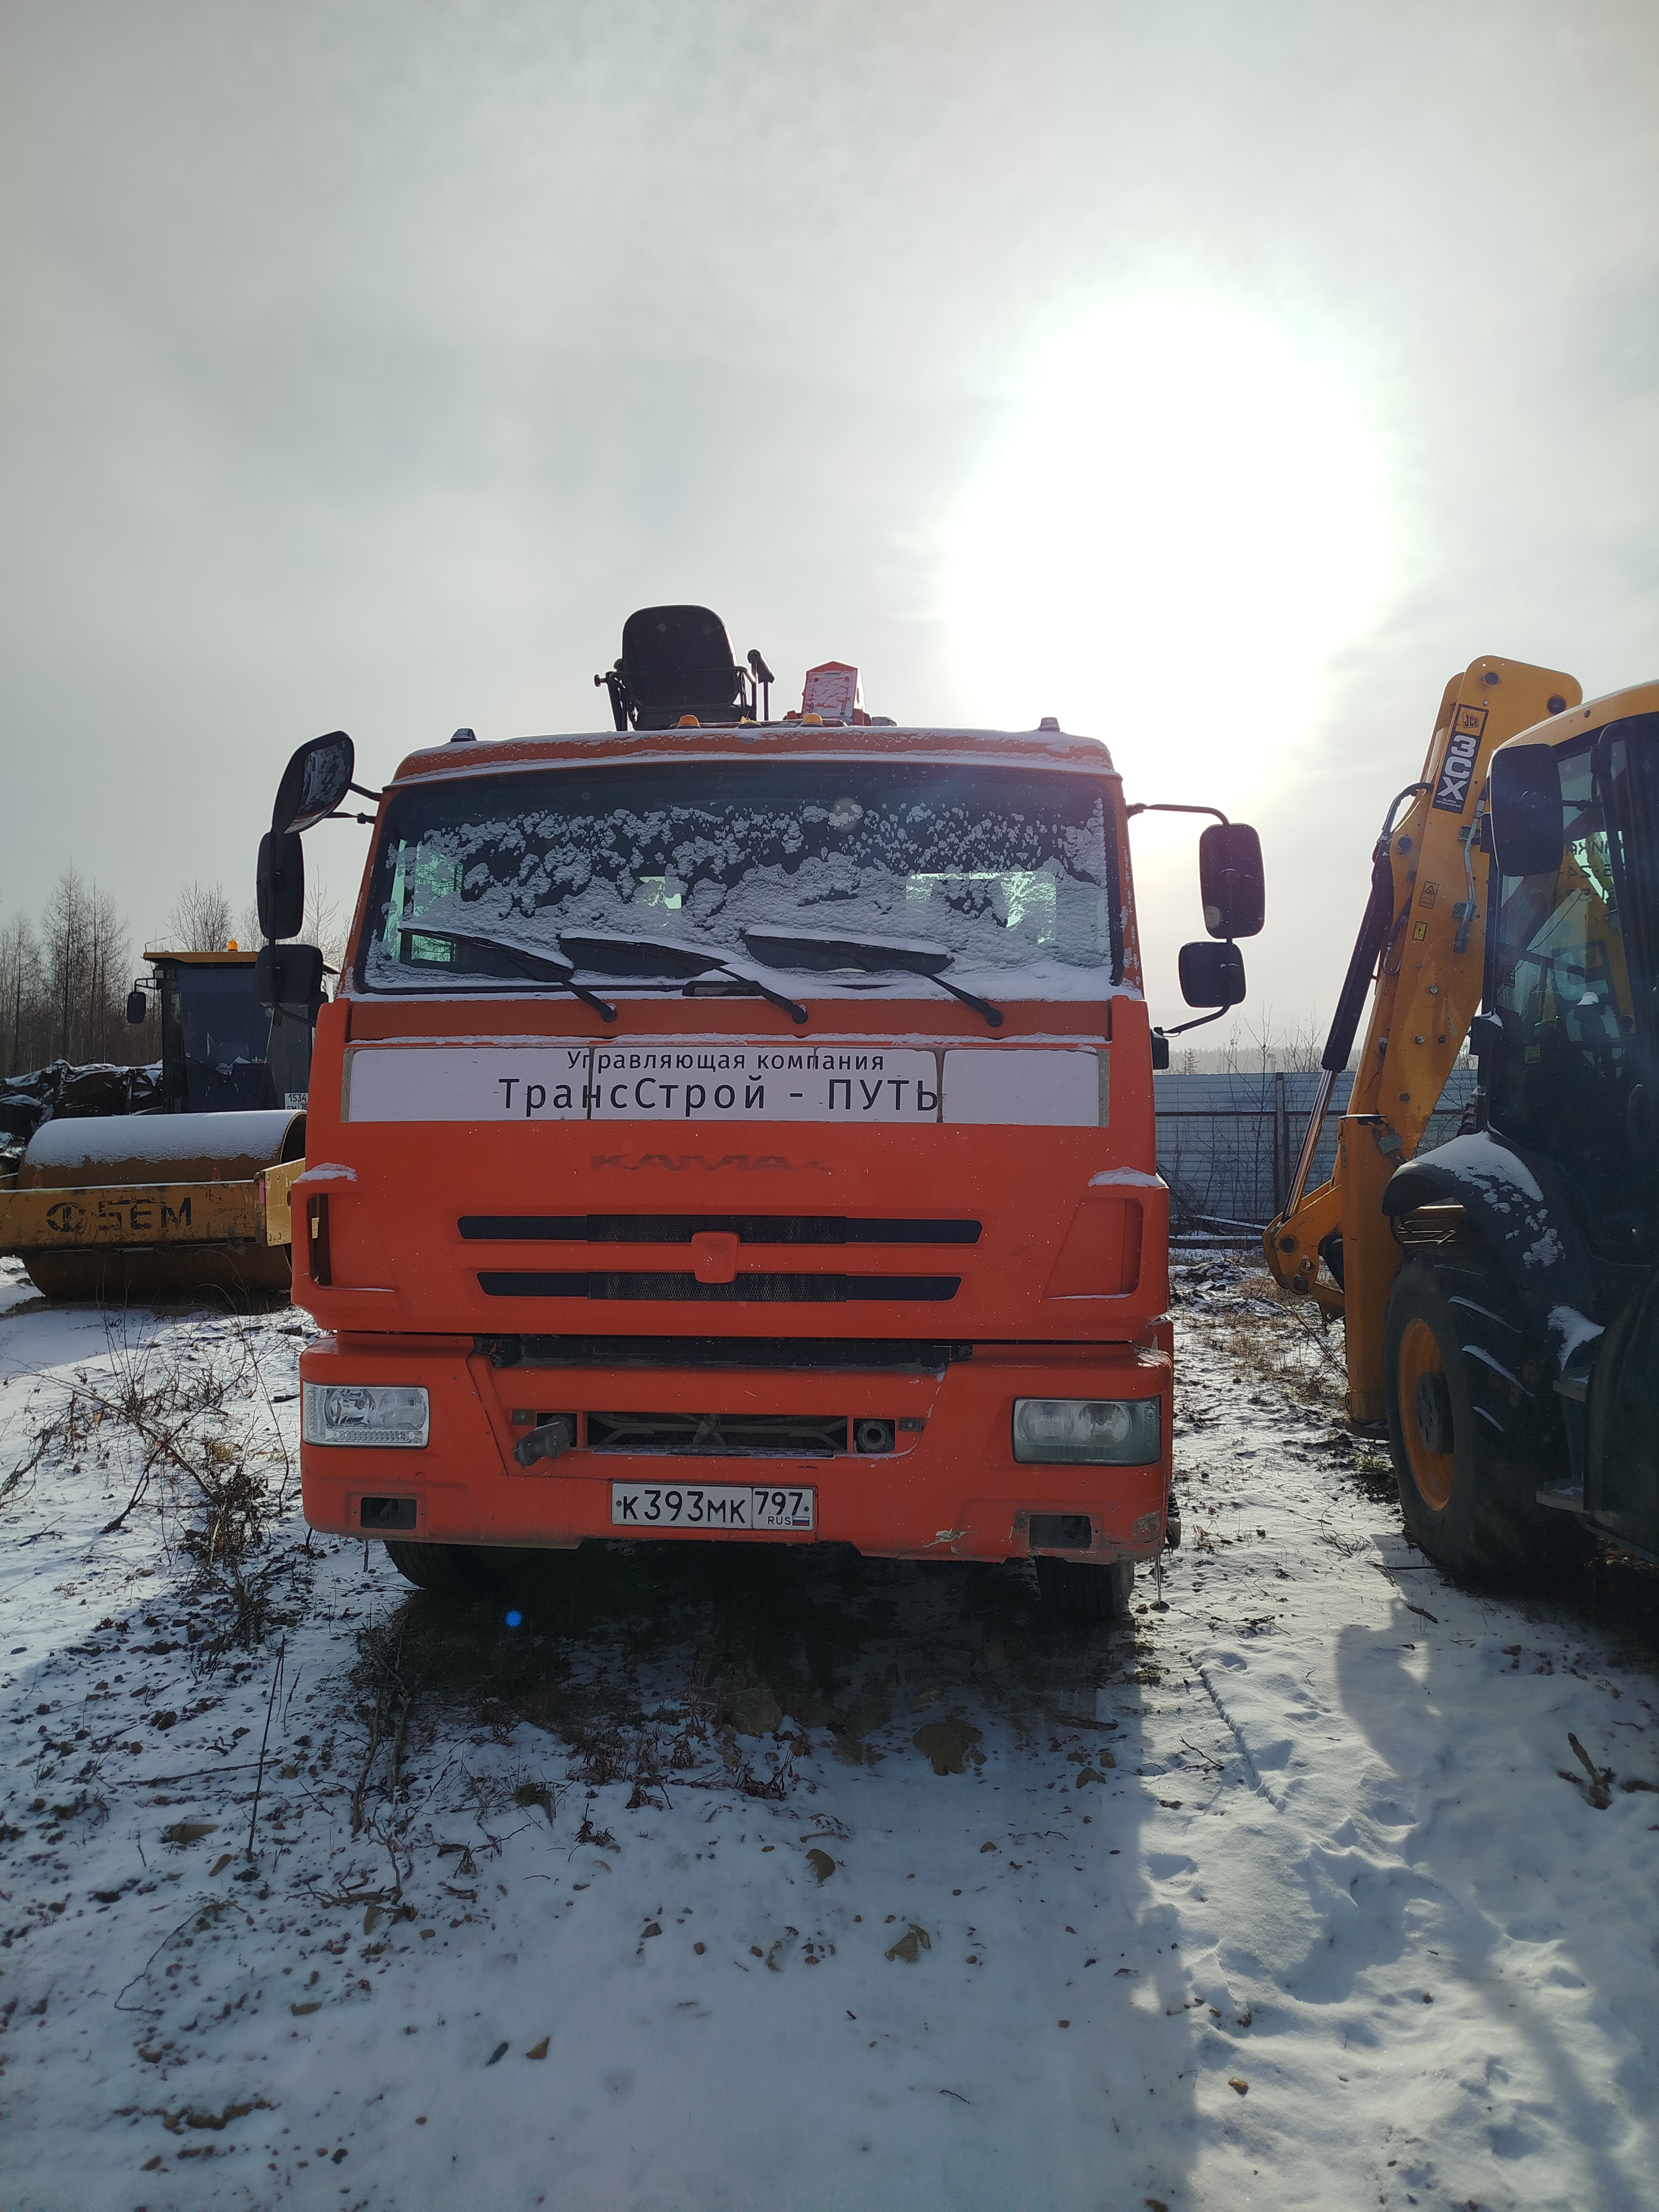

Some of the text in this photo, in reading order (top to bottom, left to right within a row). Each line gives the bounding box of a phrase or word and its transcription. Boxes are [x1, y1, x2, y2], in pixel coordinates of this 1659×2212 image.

[1464, 715, 1479, 727] JCB
[1437, 735, 1477, 801] 3CX
[567, 1051, 884, 1074] Управляющая компания
[288, 1094, 307, 1103] 1534
[498, 1074, 764, 1117] ТрансСтрой
[829, 1079, 938, 1111] ПУТЬ
[98, 1197, 191, 1232] SEM
[622, 1489, 804, 1524] К393МК 797
[768, 1516, 791, 1525] RUS
